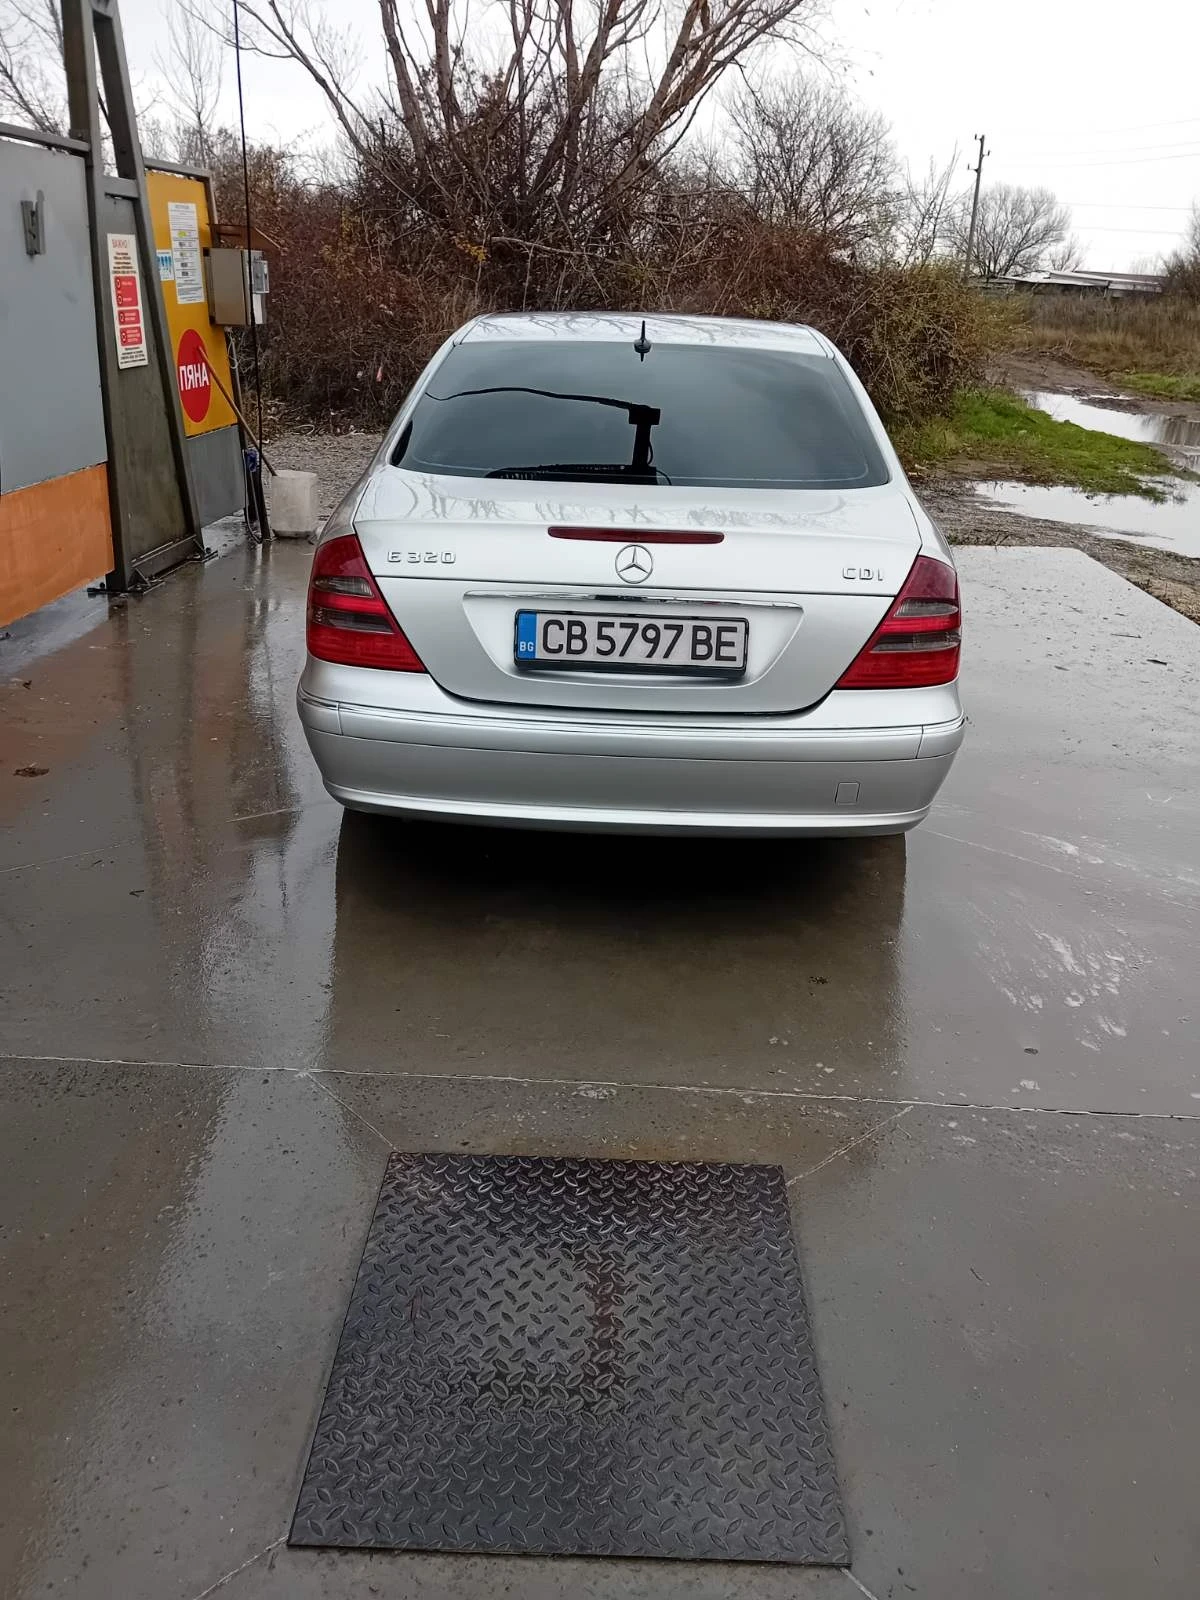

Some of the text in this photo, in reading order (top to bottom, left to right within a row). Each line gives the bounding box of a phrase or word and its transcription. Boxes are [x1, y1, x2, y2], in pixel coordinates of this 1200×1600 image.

[179, 362, 210, 391] ПЯНА
[387, 551, 456, 564] E 320
[842, 567, 884, 581] CDI
[519, 641, 534, 652] BG
[542, 619, 738, 662] CB 5797 BE
